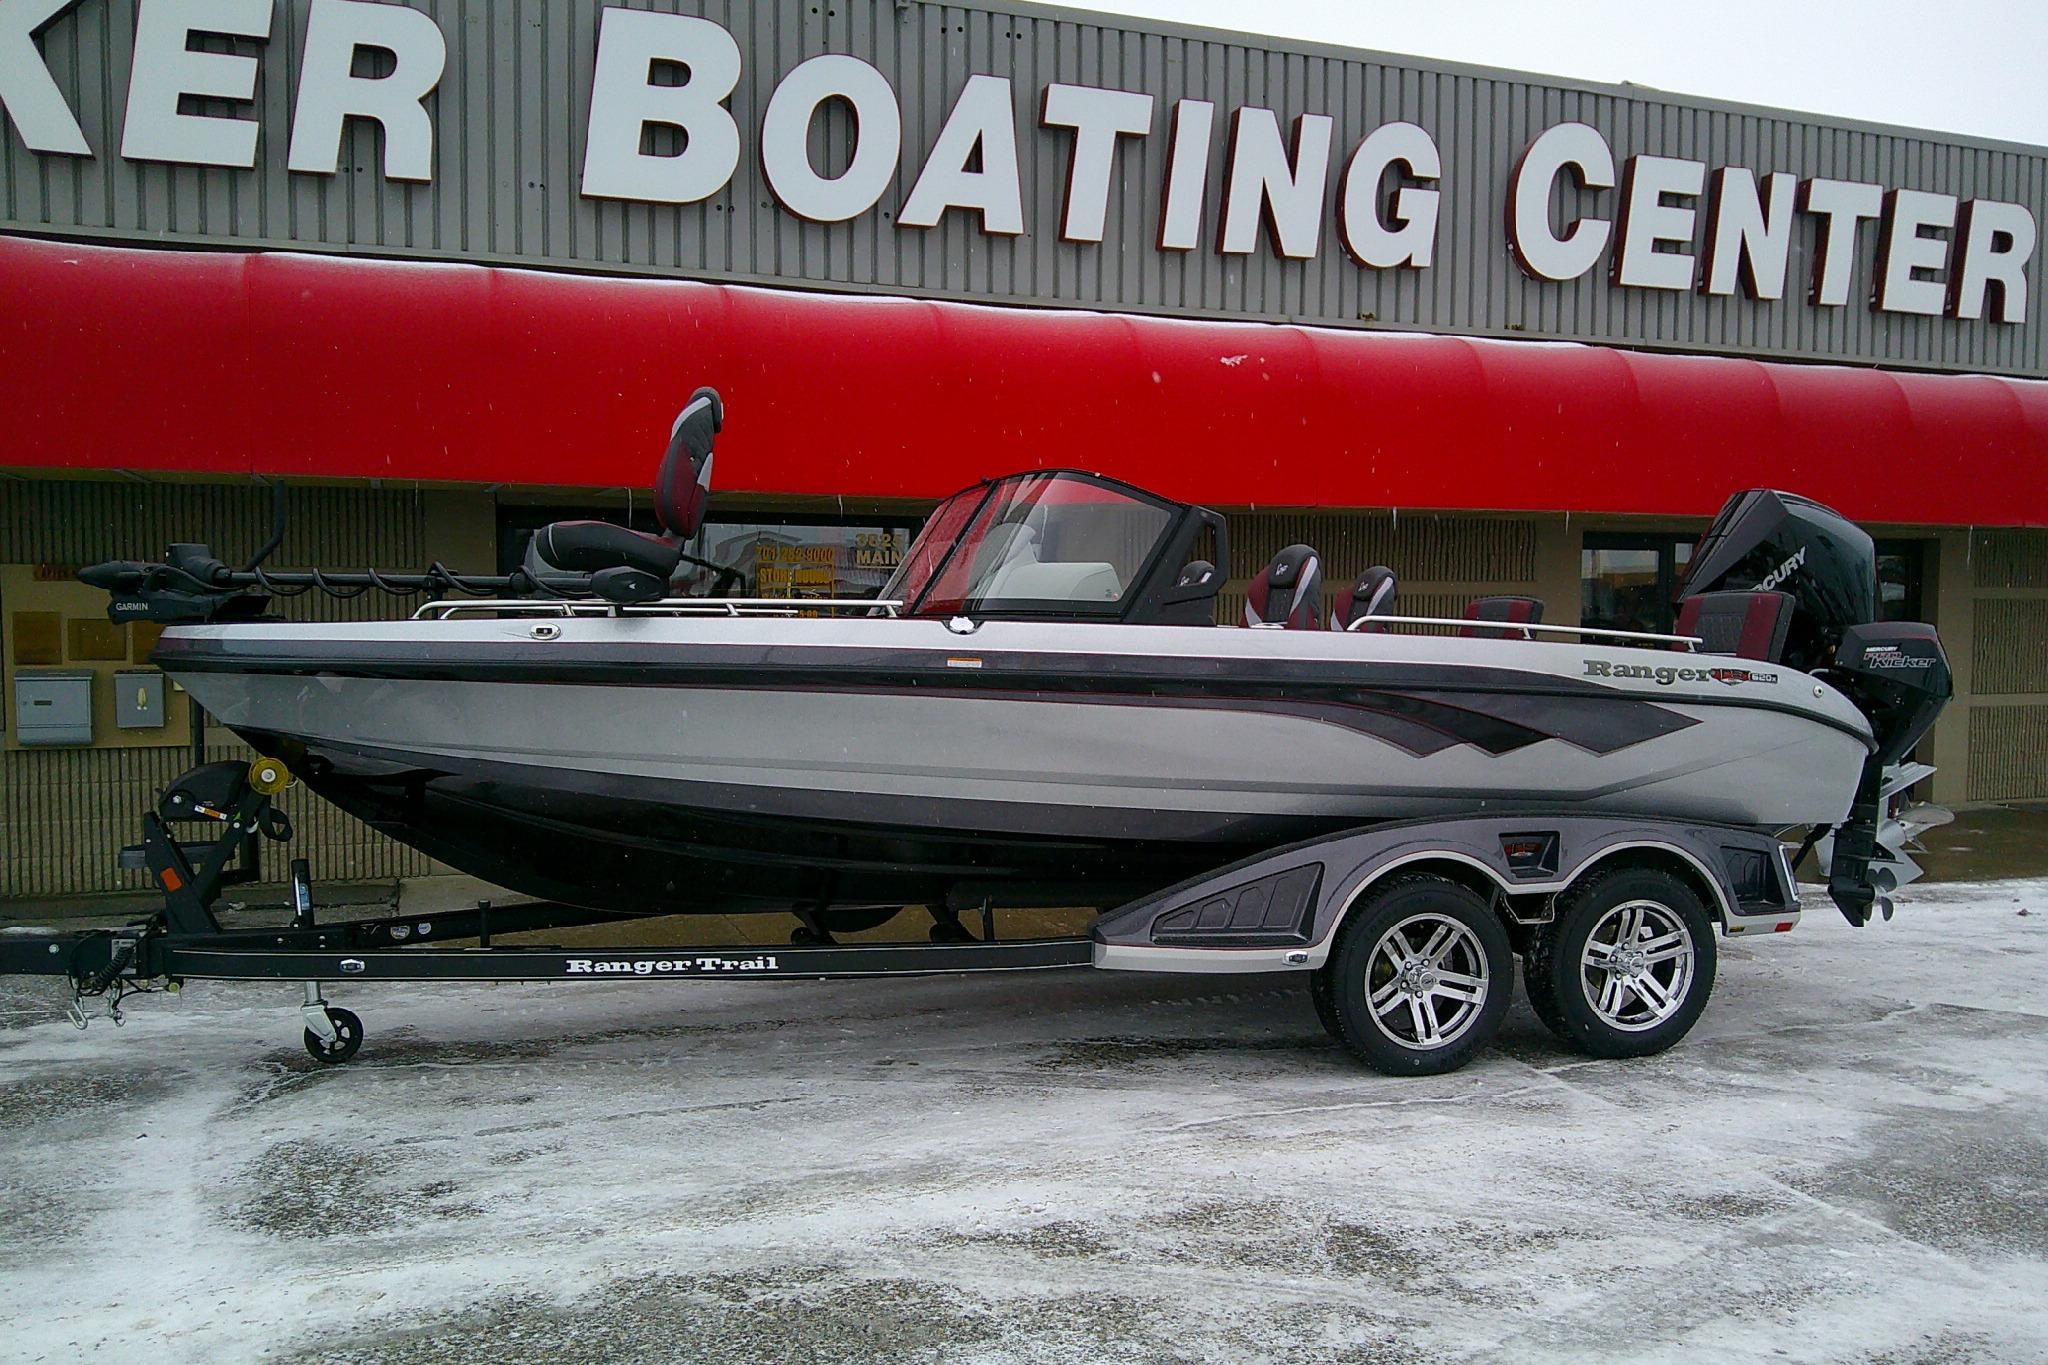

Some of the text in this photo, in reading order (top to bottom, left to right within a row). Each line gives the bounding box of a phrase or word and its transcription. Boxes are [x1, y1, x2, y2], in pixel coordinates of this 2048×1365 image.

[581, 6, 1441, 268] BOATING
[1506, 121, 2037, 324] CENTER
[856, 550, 904, 565] MAIN
[115, 602, 149, 611] GARMIN
[1869, 656, 1937, 669] Kicker
[1583, 659, 1713, 686] Ranger
[565, 956, 779, 975] Ranger Trail
